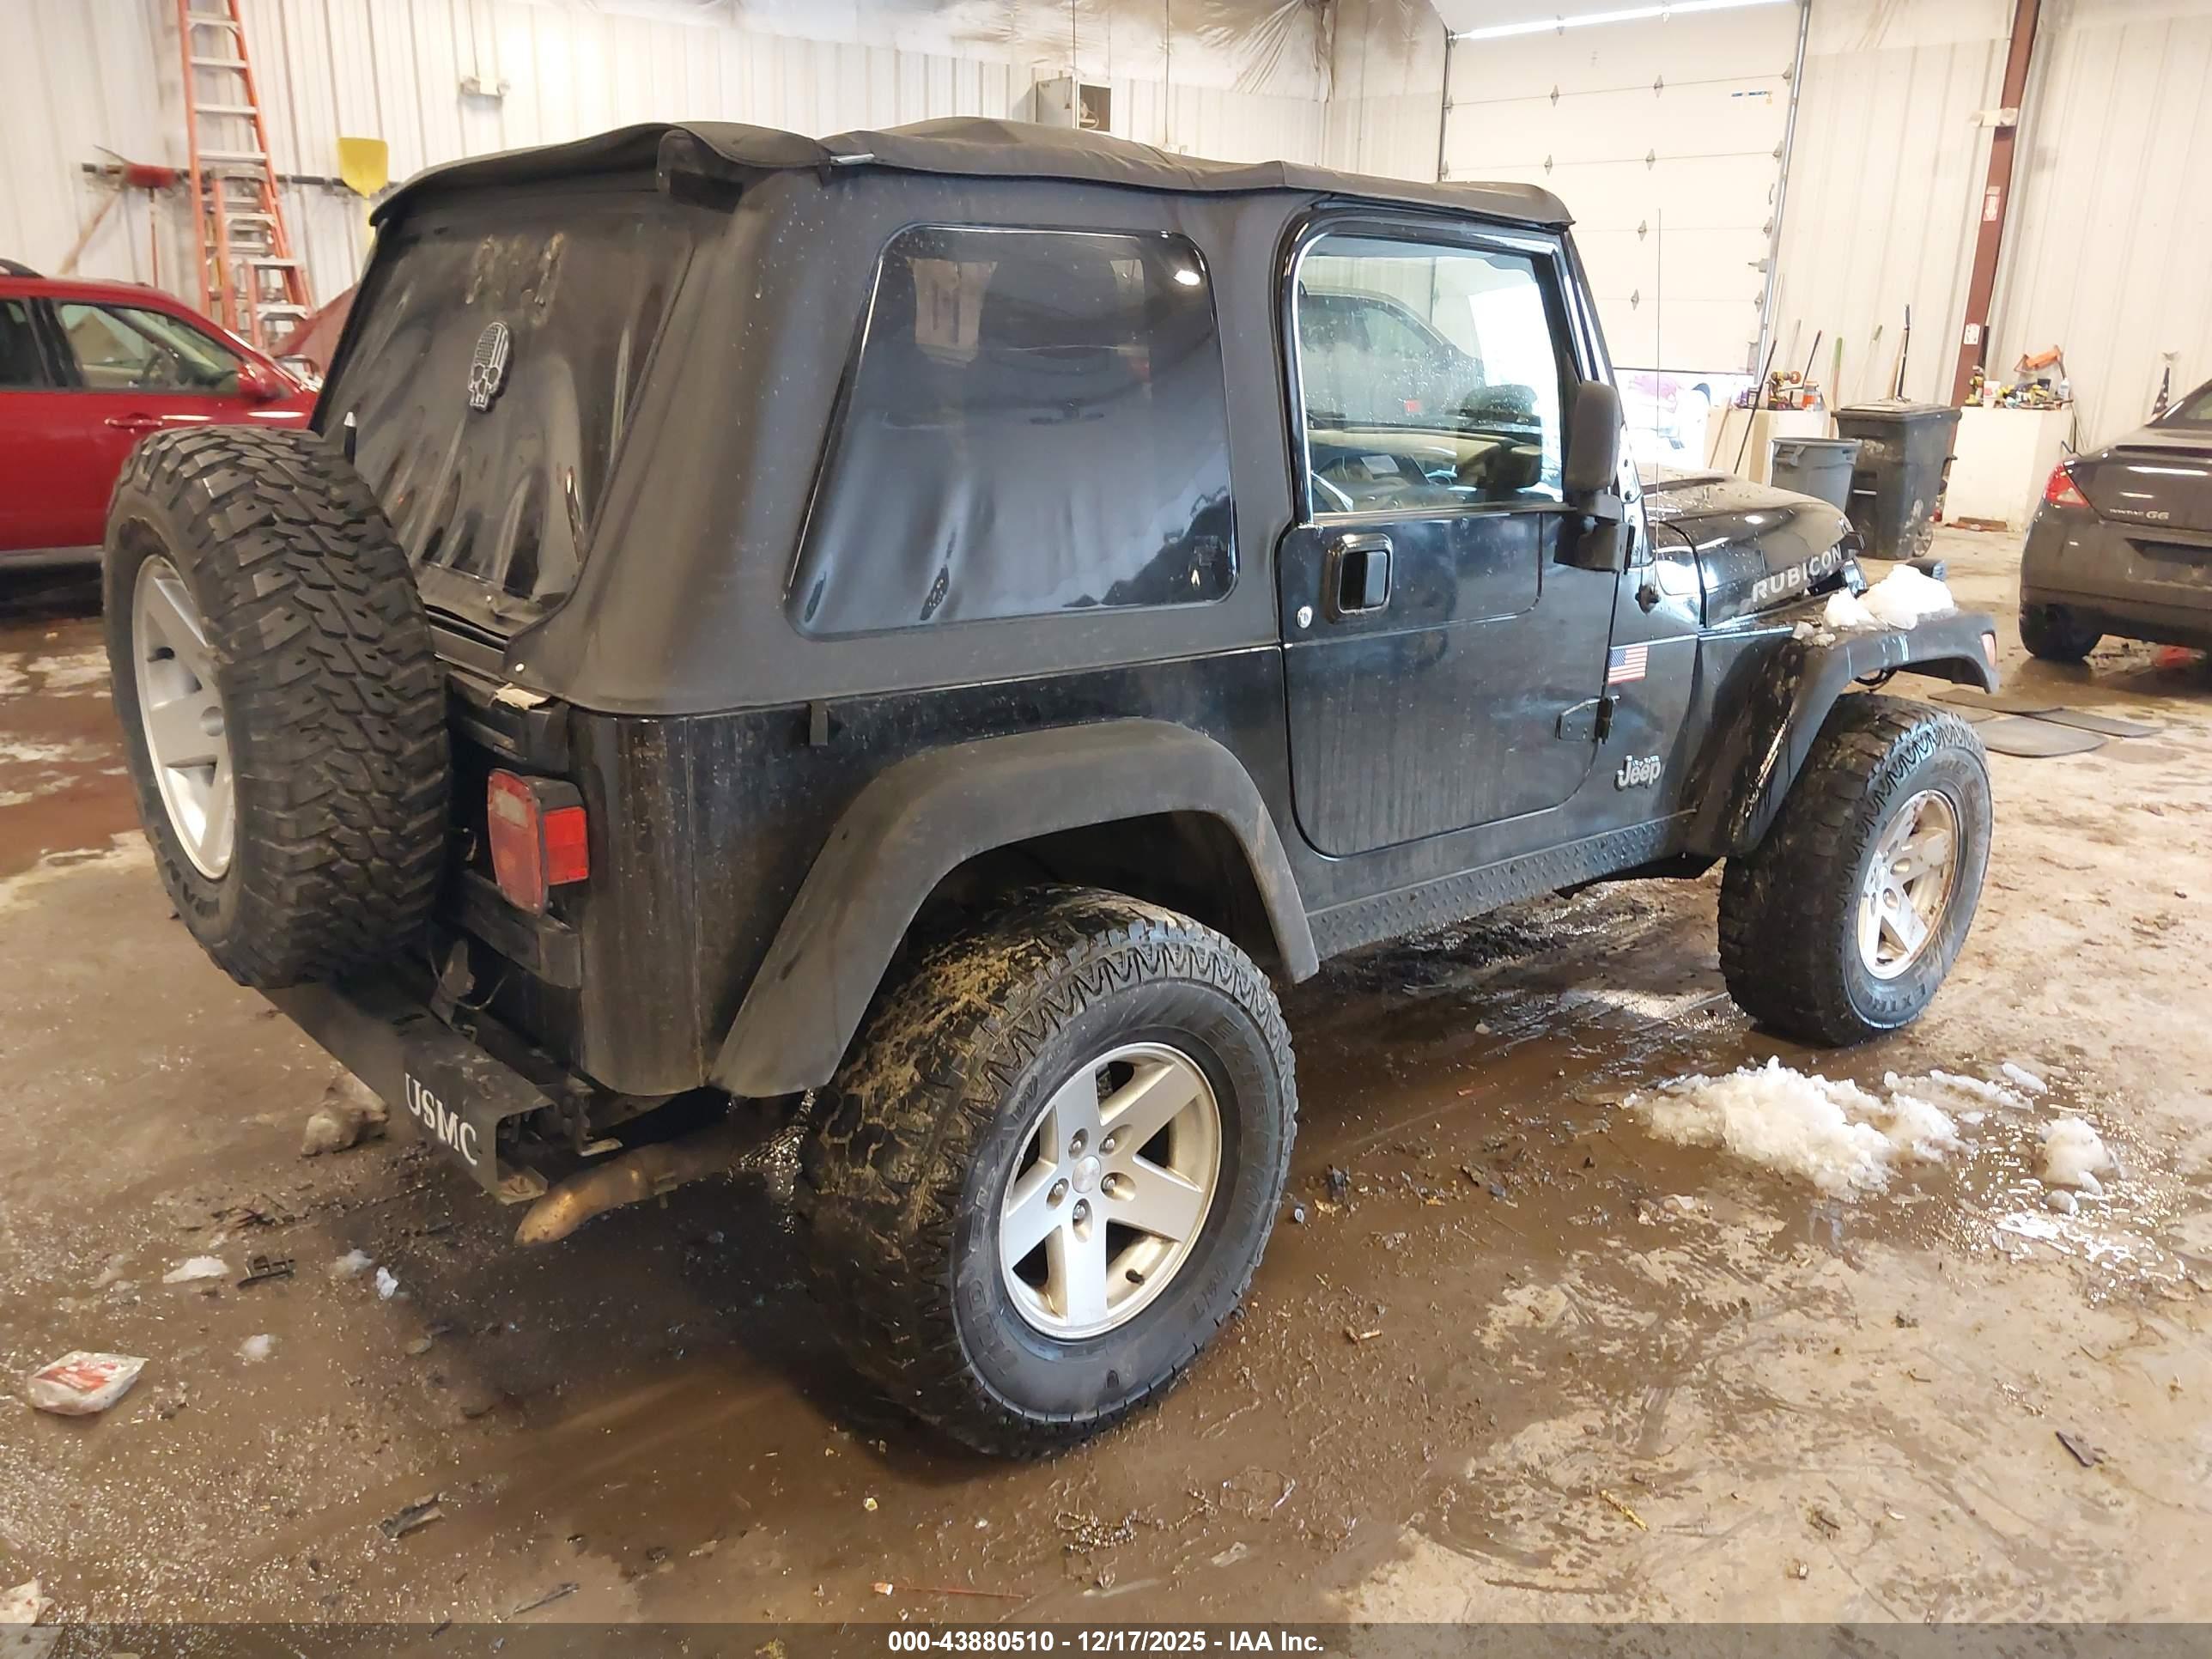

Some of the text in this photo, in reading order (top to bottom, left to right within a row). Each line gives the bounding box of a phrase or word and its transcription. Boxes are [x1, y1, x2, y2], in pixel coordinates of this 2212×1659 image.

[1752, 543, 1843, 603] RUBICON
[1616, 755, 1661, 787] Jeep
[404, 1072, 478, 1166] USMC
